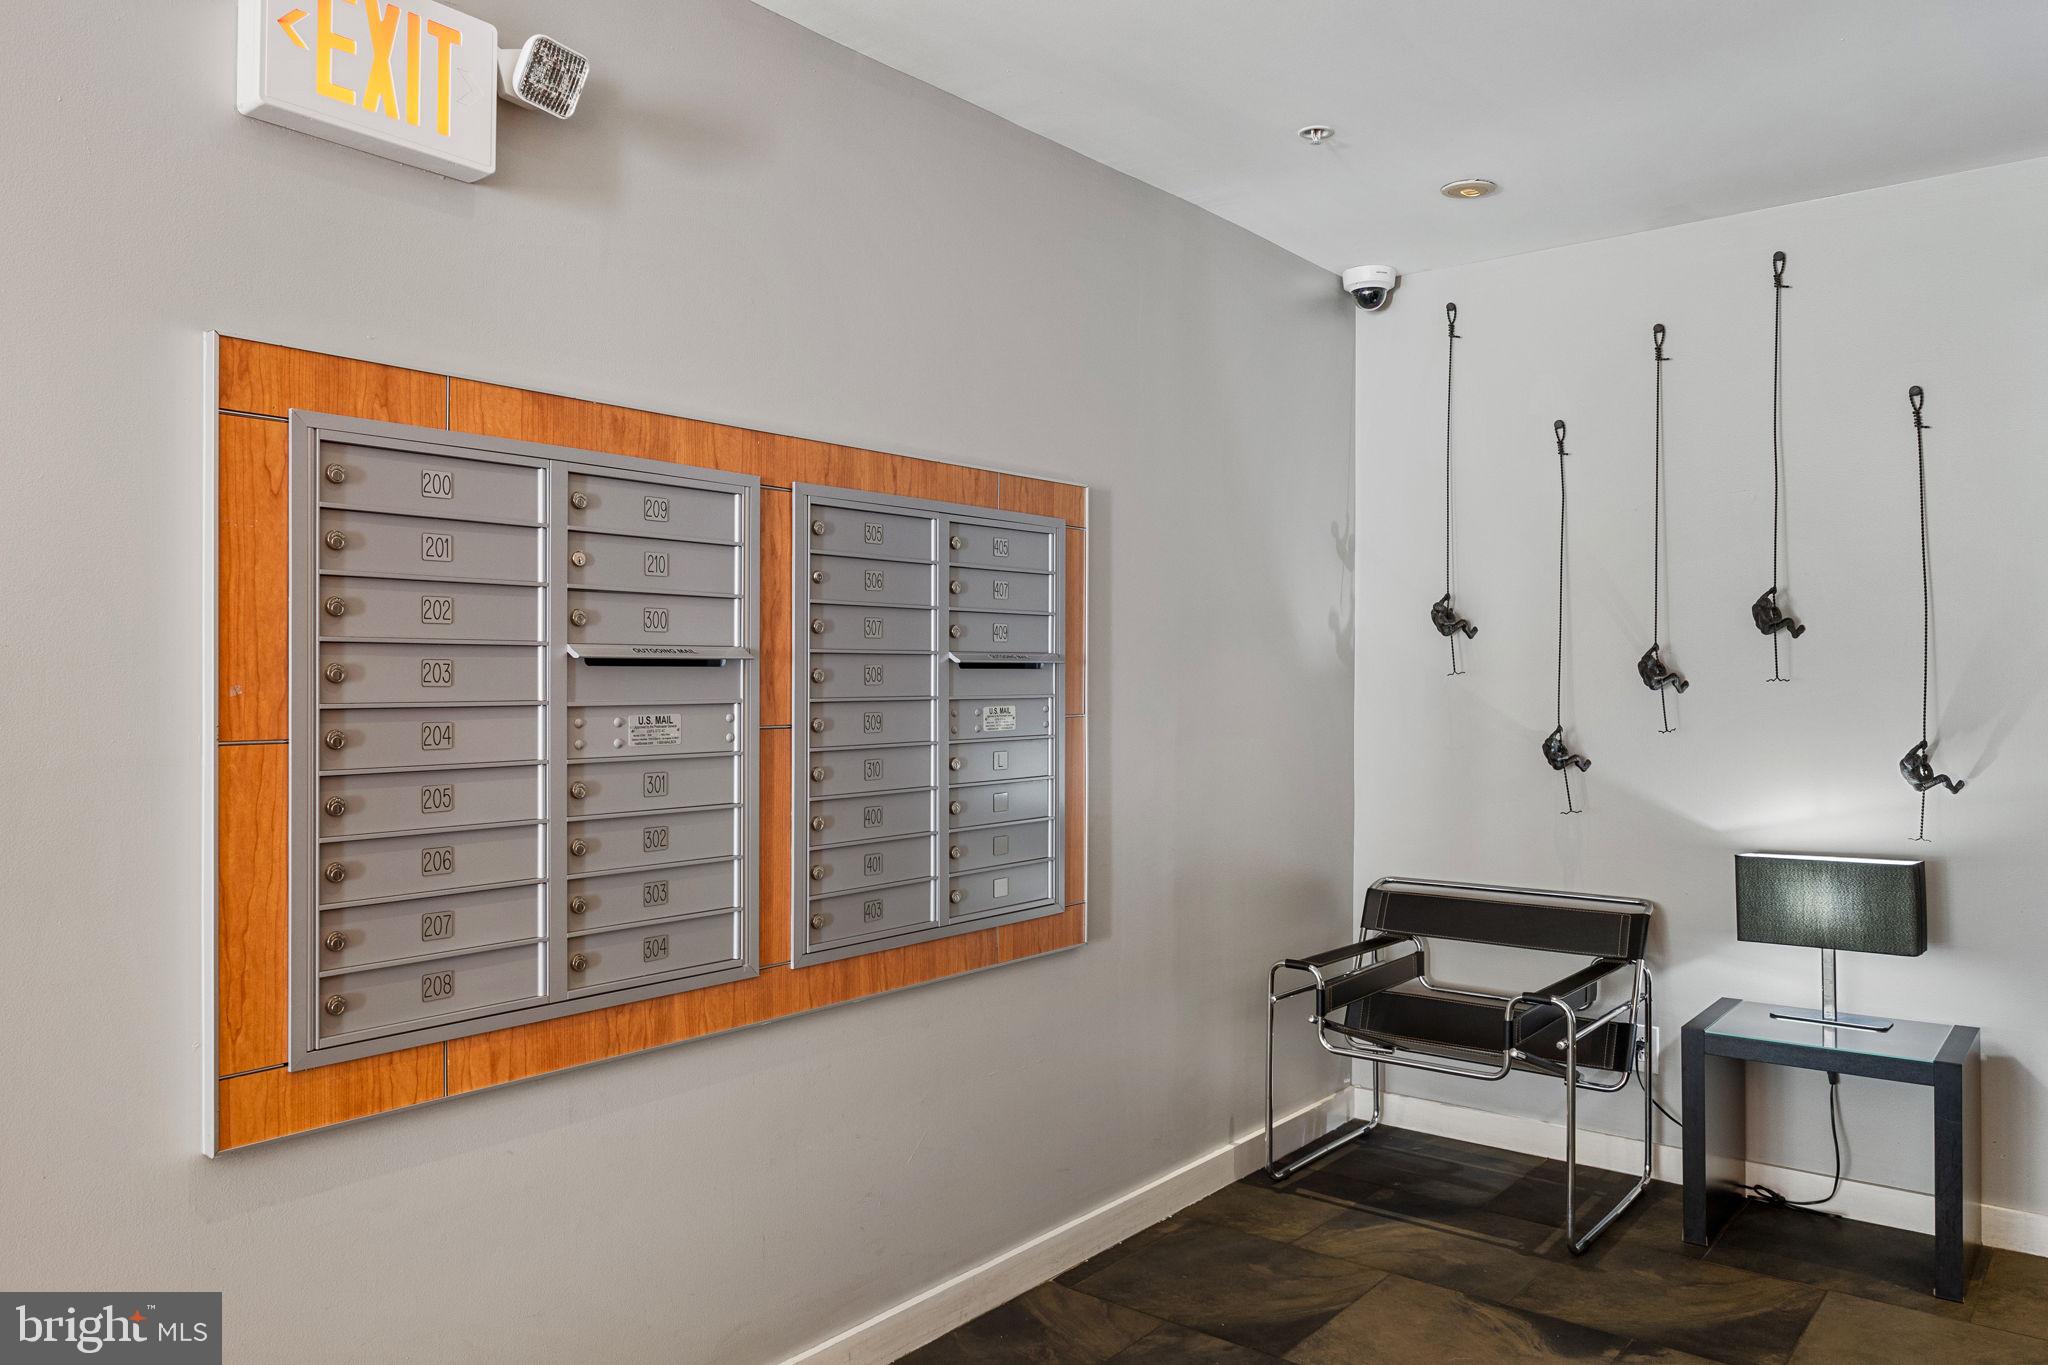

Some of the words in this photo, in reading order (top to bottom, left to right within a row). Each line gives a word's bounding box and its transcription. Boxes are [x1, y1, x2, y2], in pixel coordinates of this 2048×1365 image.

[316, 0, 462, 137] EXIT
[424, 473, 451, 495] 200
[646, 499, 667, 518] 209
[866, 525, 882, 541] 305
[426, 537, 449, 558] 201
[994, 538, 1008, 555] 405
[648, 555, 665, 573] 210
[866, 572, 882, 588] 306
[994, 581, 1008, 597] 407
[424, 600, 450, 620] 202
[645, 611, 666, 628] 300
[866, 620, 882, 635] 307
[994, 625, 1007, 640] 409
[632, 647, 676, 655] OUTGOING
[424, 663, 450, 683] 203
[866, 667, 882, 682] 308
[638, 715, 653, 725] U.S.
[655, 715, 673, 724] MAIL
[865, 714, 882, 730] 309
[424, 726, 451, 746] 204
[866, 762, 880, 777] 310
[647, 775, 664, 793] 301
[424, 788, 451, 809] 205
[865, 808, 881, 825] 400
[646, 829, 666, 848] 302
[424, 850, 451, 872] 206
[867, 856, 880, 872] 401
[646, 883, 666, 904] 303
[865, 902, 881, 919] 403
[425, 915, 451, 937] 207
[645, 938, 666, 958] 304
[424, 974, 451, 998] 208
